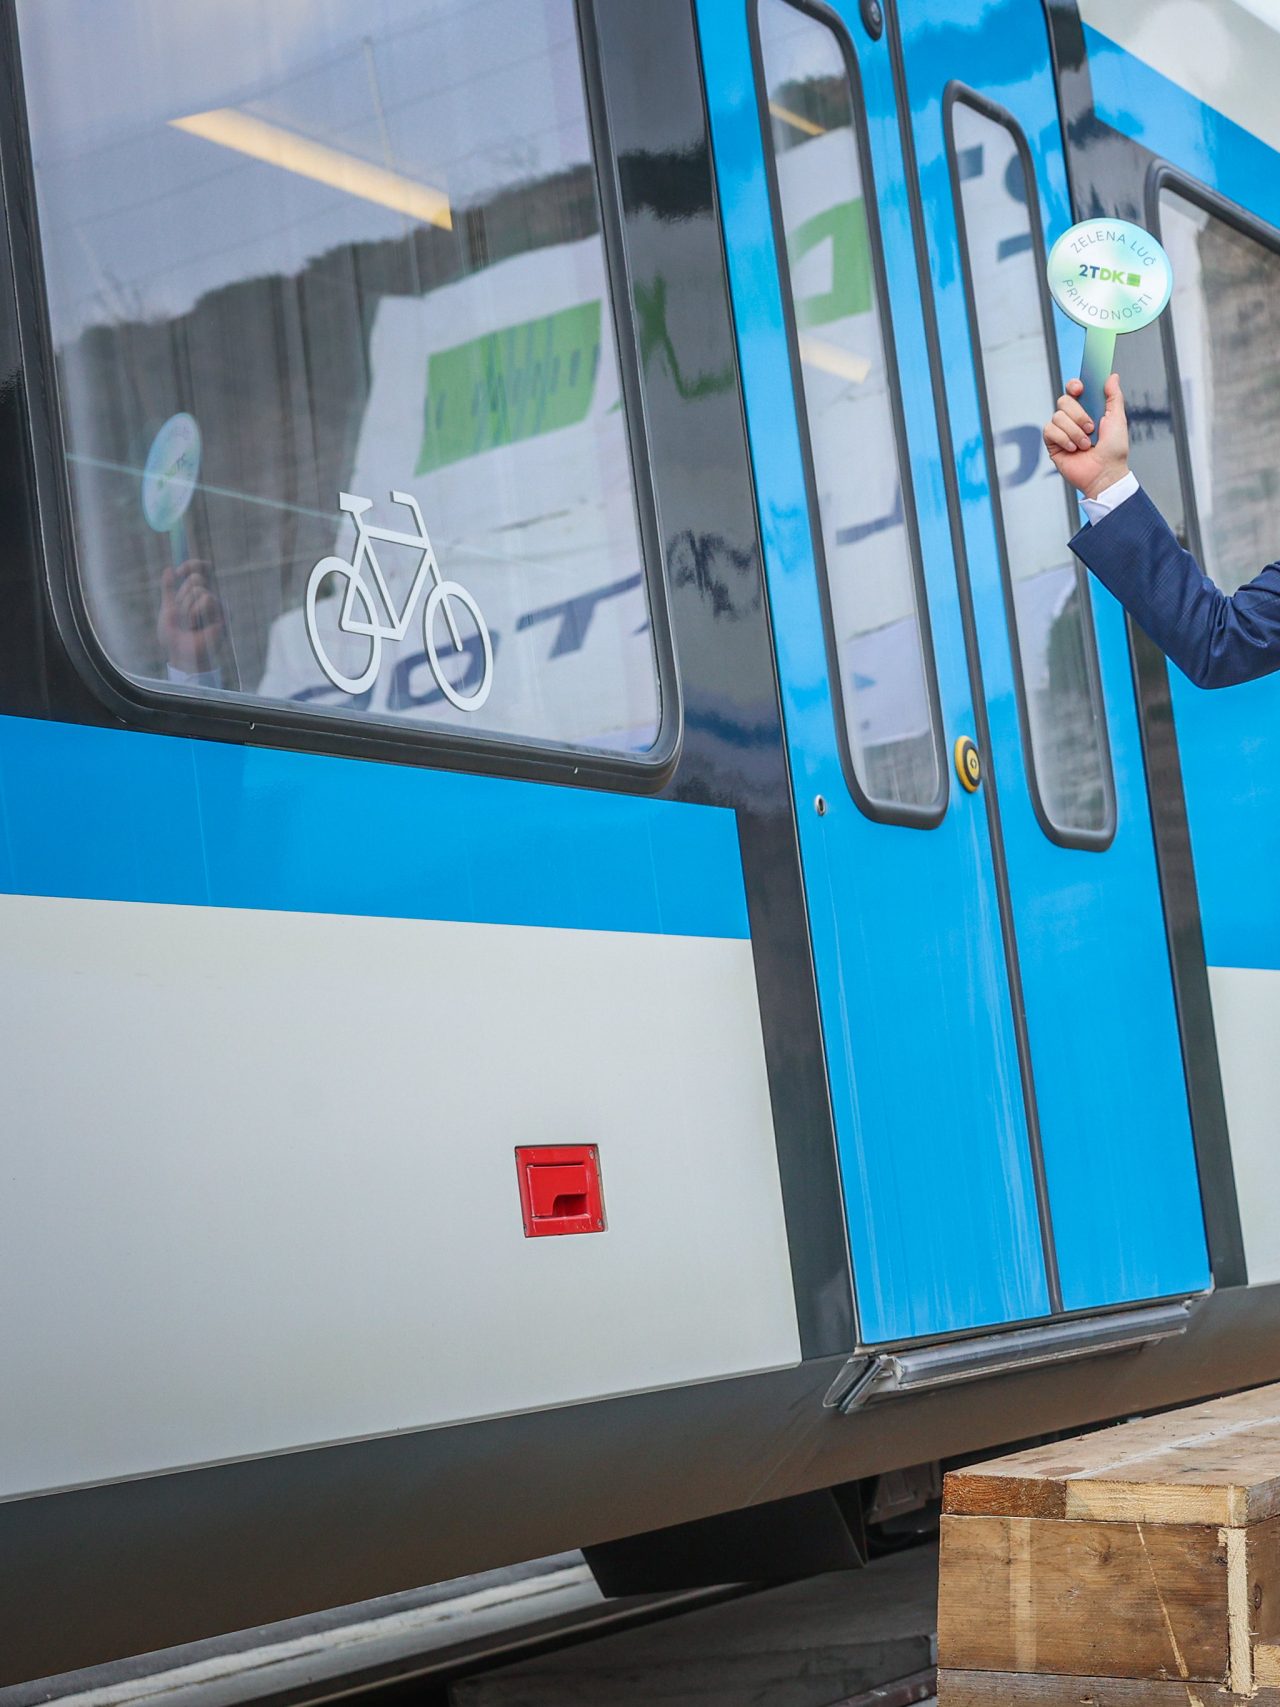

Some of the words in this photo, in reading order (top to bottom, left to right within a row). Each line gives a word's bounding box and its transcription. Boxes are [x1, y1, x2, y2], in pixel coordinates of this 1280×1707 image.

[1070, 230, 1126, 254] ZELENA
[1079, 264, 1125, 285] 2TDK
[1063, 279, 1153, 320] PRIHODNOSTI
